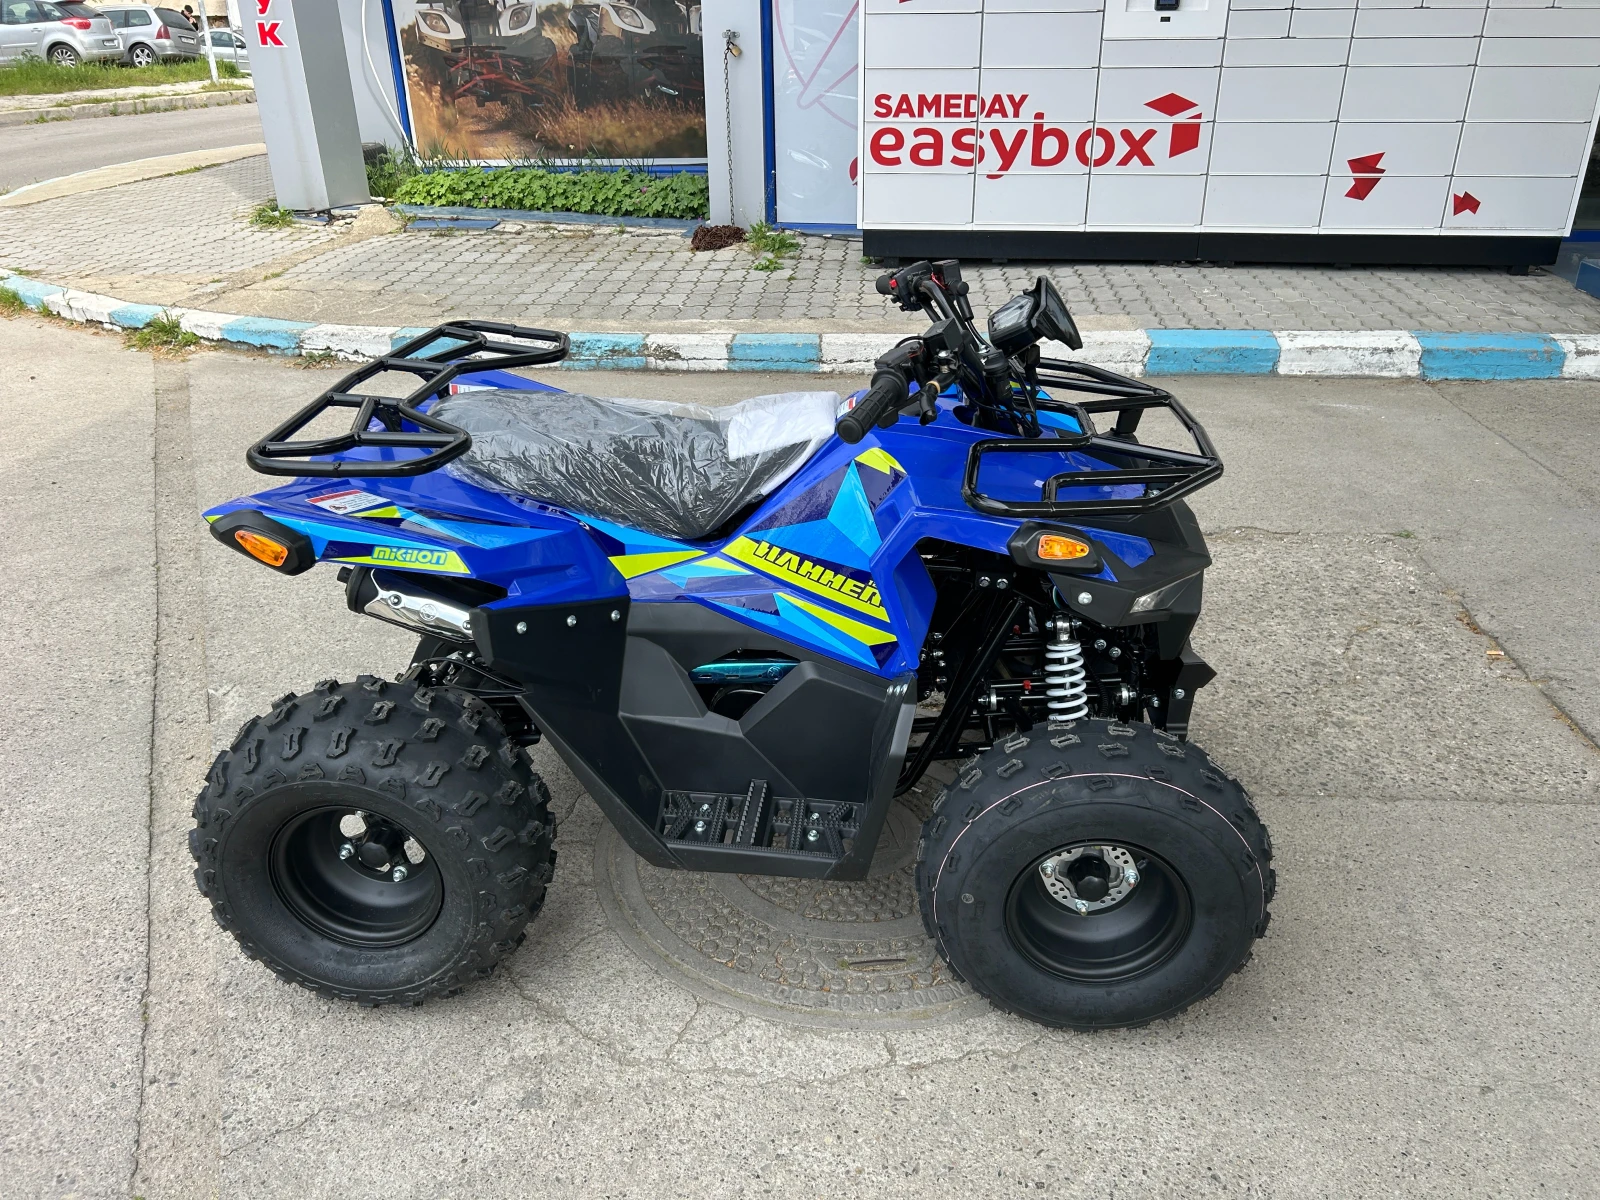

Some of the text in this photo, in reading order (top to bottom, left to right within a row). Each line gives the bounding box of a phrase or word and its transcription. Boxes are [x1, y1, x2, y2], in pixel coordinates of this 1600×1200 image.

[873, 93, 1029, 119] SAMEDAY
[870, 112, 1158, 180] easybox
[753, 539, 882, 608] HAMMER
